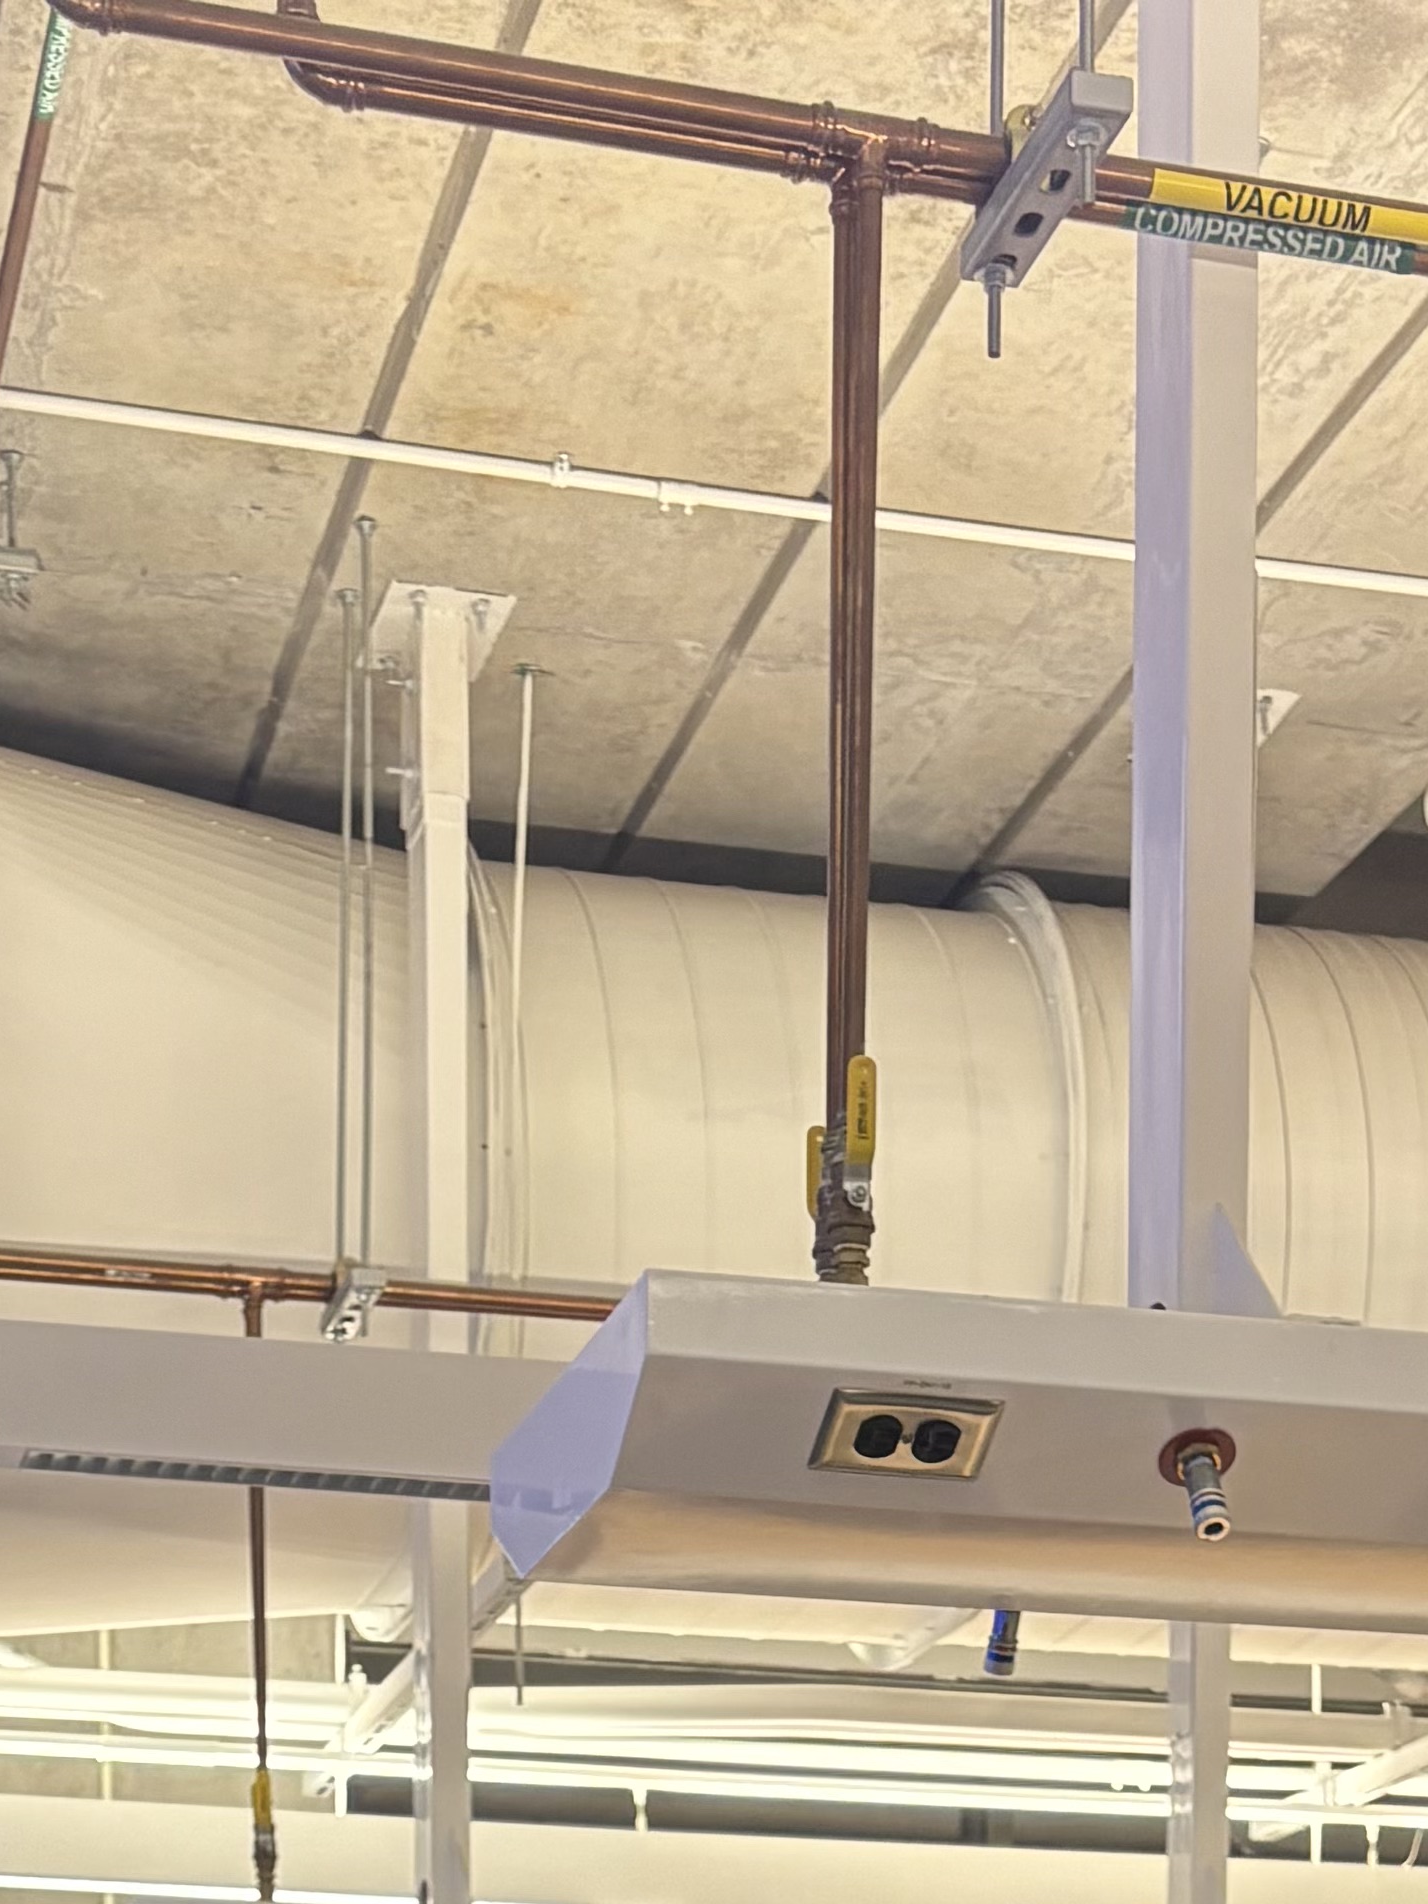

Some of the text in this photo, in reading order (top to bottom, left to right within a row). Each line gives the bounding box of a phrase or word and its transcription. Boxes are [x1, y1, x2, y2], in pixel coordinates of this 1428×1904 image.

[1224, 181, 1372, 233] VACUUM
[1134, 204, 1402, 271] COMPRESSED AIR
